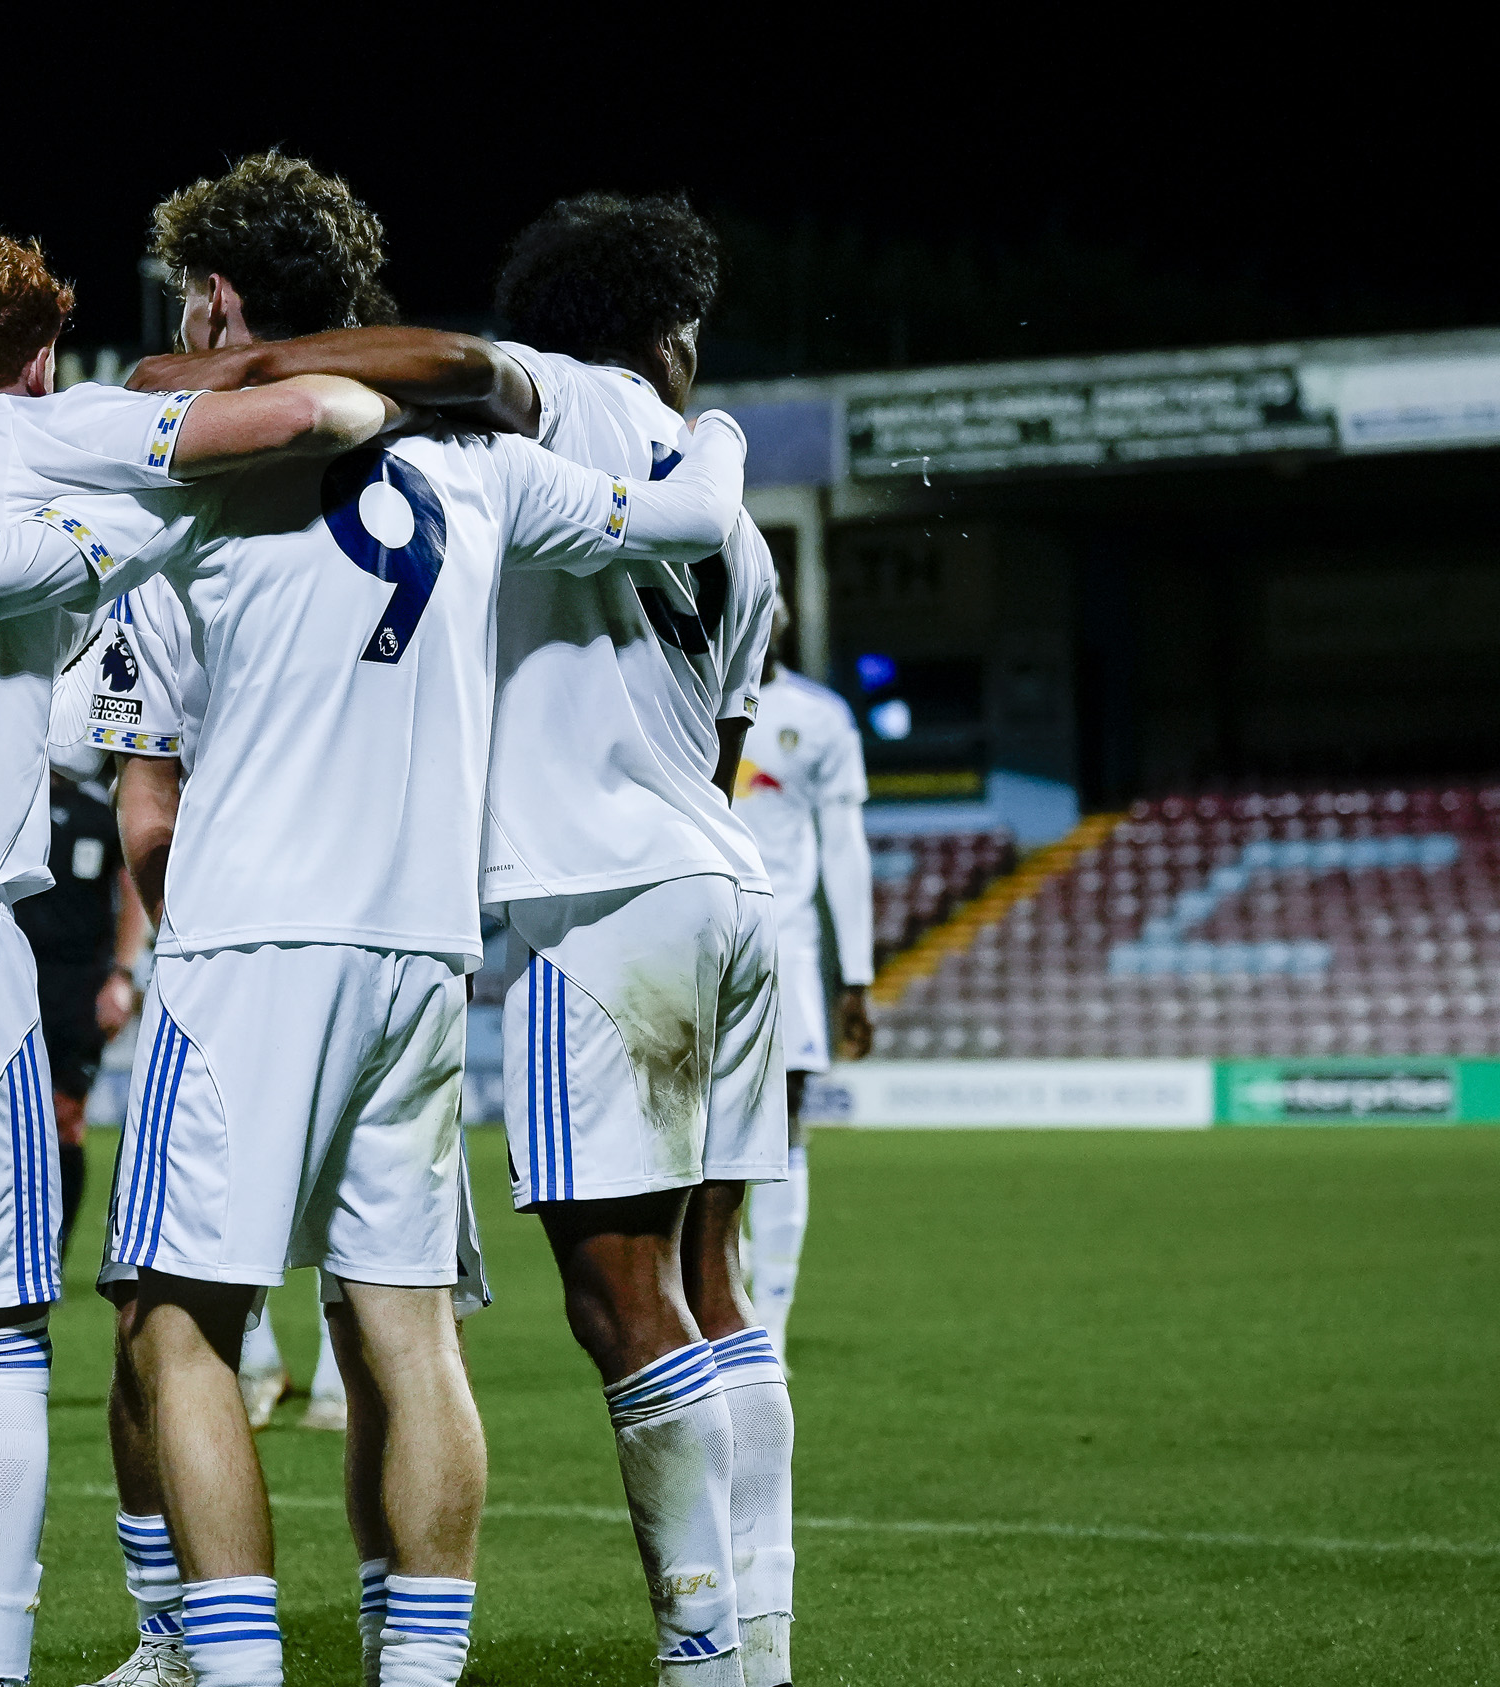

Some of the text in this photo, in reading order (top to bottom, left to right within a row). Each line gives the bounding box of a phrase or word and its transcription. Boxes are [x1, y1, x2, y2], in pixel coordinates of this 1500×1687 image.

[320, 448, 447, 664] 9
[104, 699, 137, 713] room
[102, 711, 141, 725] racism
[484, 864, 514, 874] AEROREADY
